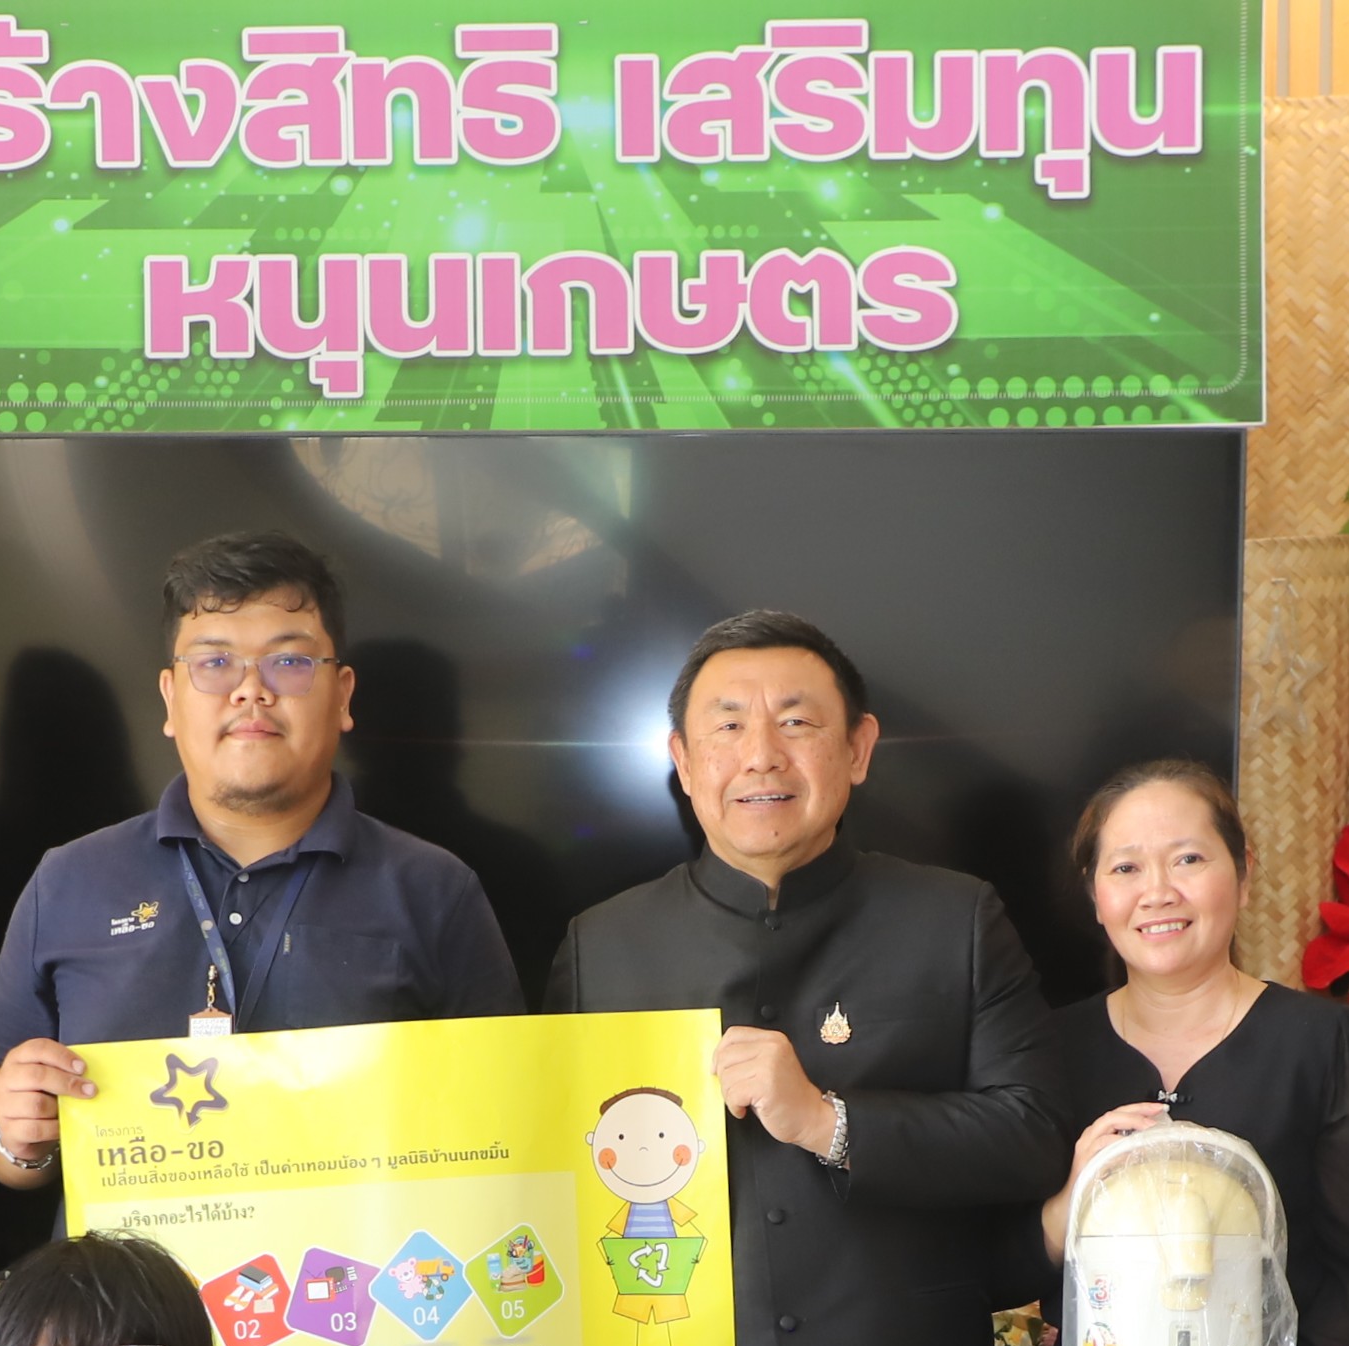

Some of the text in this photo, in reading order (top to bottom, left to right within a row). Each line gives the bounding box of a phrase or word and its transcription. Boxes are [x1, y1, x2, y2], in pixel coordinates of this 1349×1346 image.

[617, 21, 1201, 196] เสริมทุน
[145, 247, 957, 397] หนุนเกษตร
[97, 1136, 225, 1167] เหลือ-ขอ
[101, 1162, 249, 1187] เปลี่ยนสิ่งของเหลือใช้
[122, 1201, 255, 1228] บริจาคอะไรได้บ้าง?
[331, 1312, 357, 1333] 03
[413, 1305, 440, 1326] 04
[501, 1300, 525, 1320] 05
[234, 1319, 261, 1340] 02
